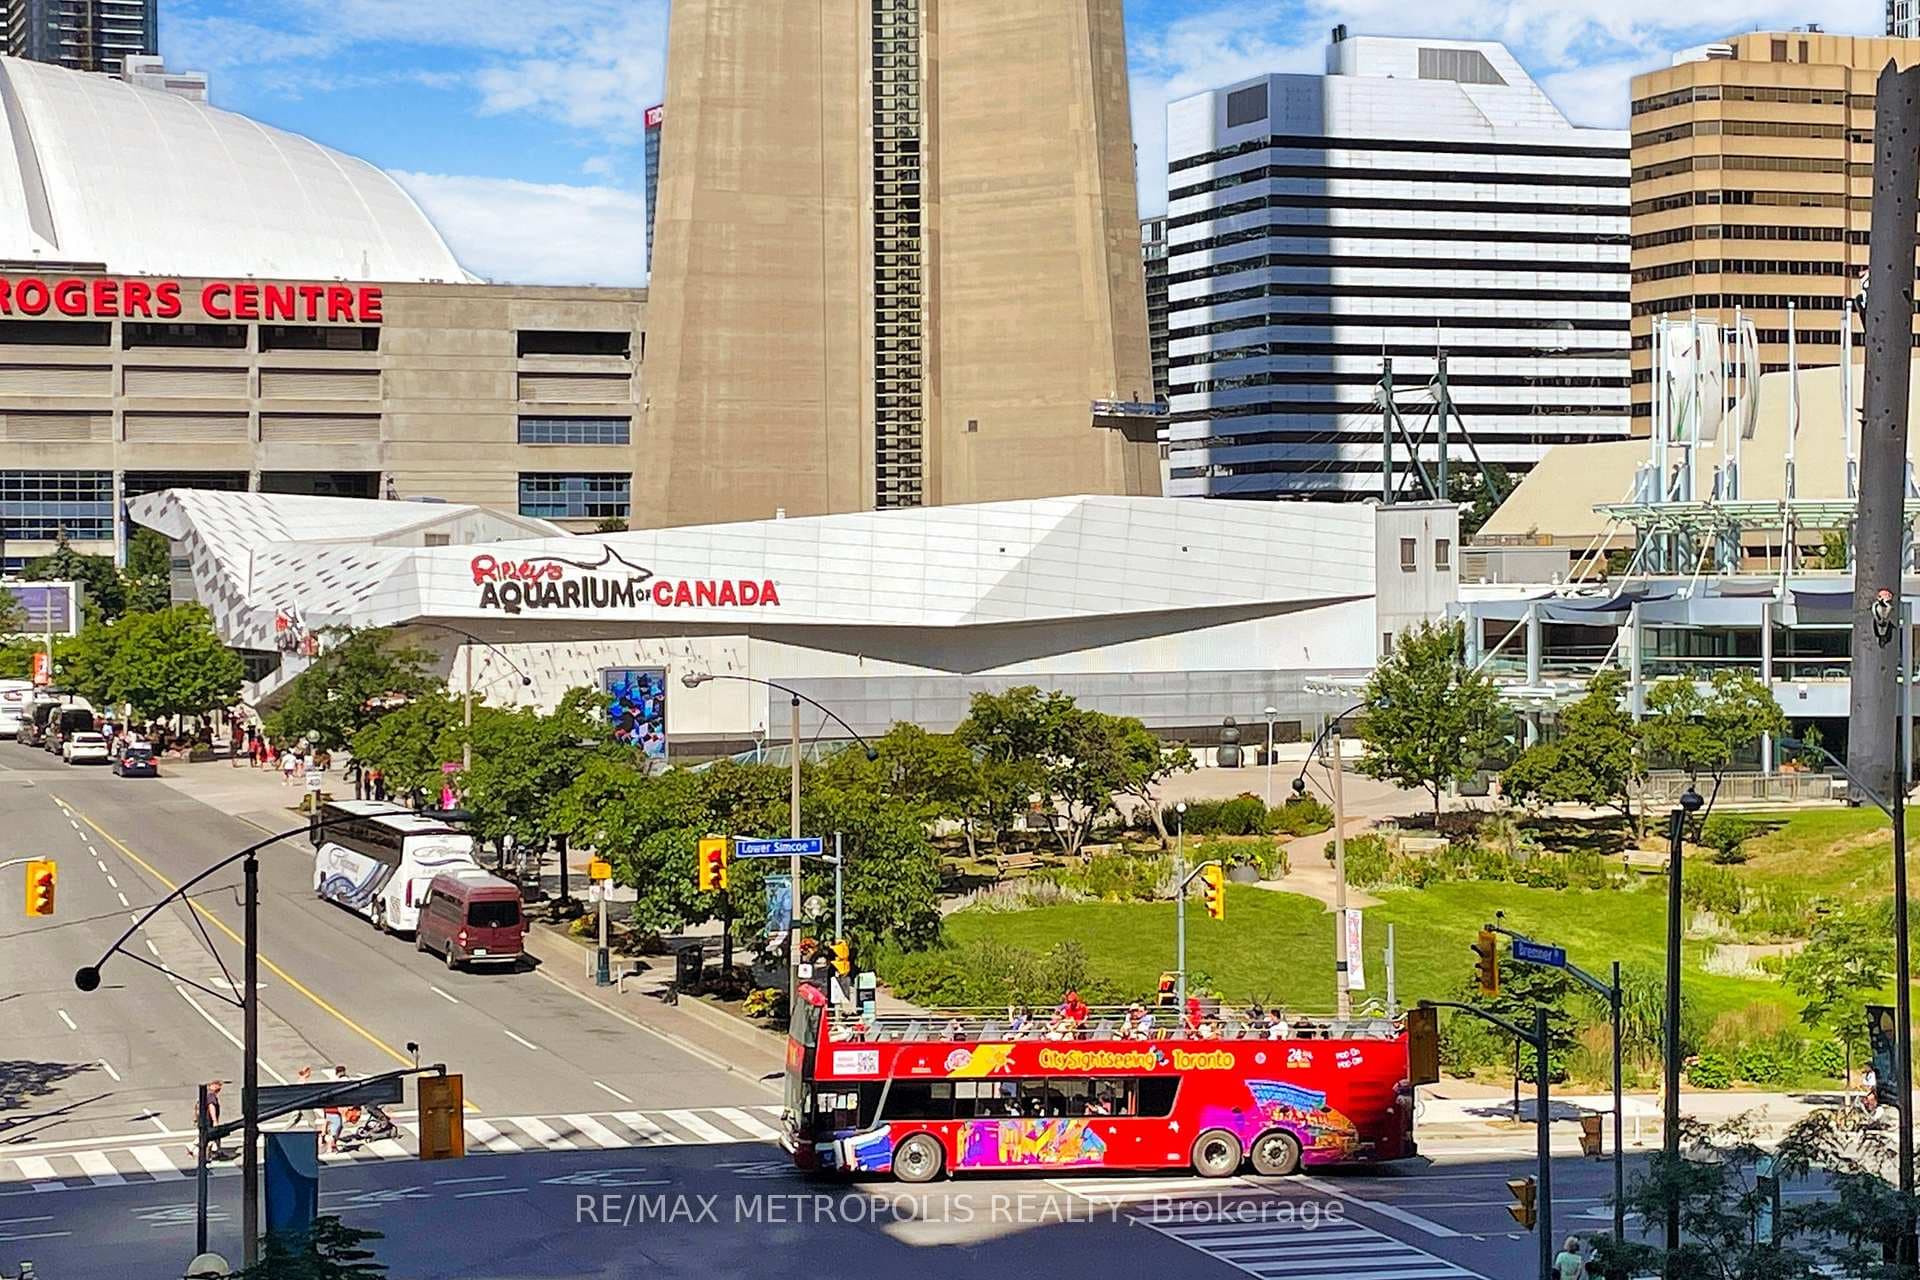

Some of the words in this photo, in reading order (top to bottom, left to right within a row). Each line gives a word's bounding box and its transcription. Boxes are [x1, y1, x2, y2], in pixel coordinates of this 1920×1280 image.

[201, 282, 383, 323] CENTRE
[480, 576, 635, 614] AQUARIUM
[652, 580, 780, 607] CANADA
[741, 842, 772, 854] Lower
[773, 841, 809, 853] Simcoe
[1172, 1048, 1236, 1070] Toronto
